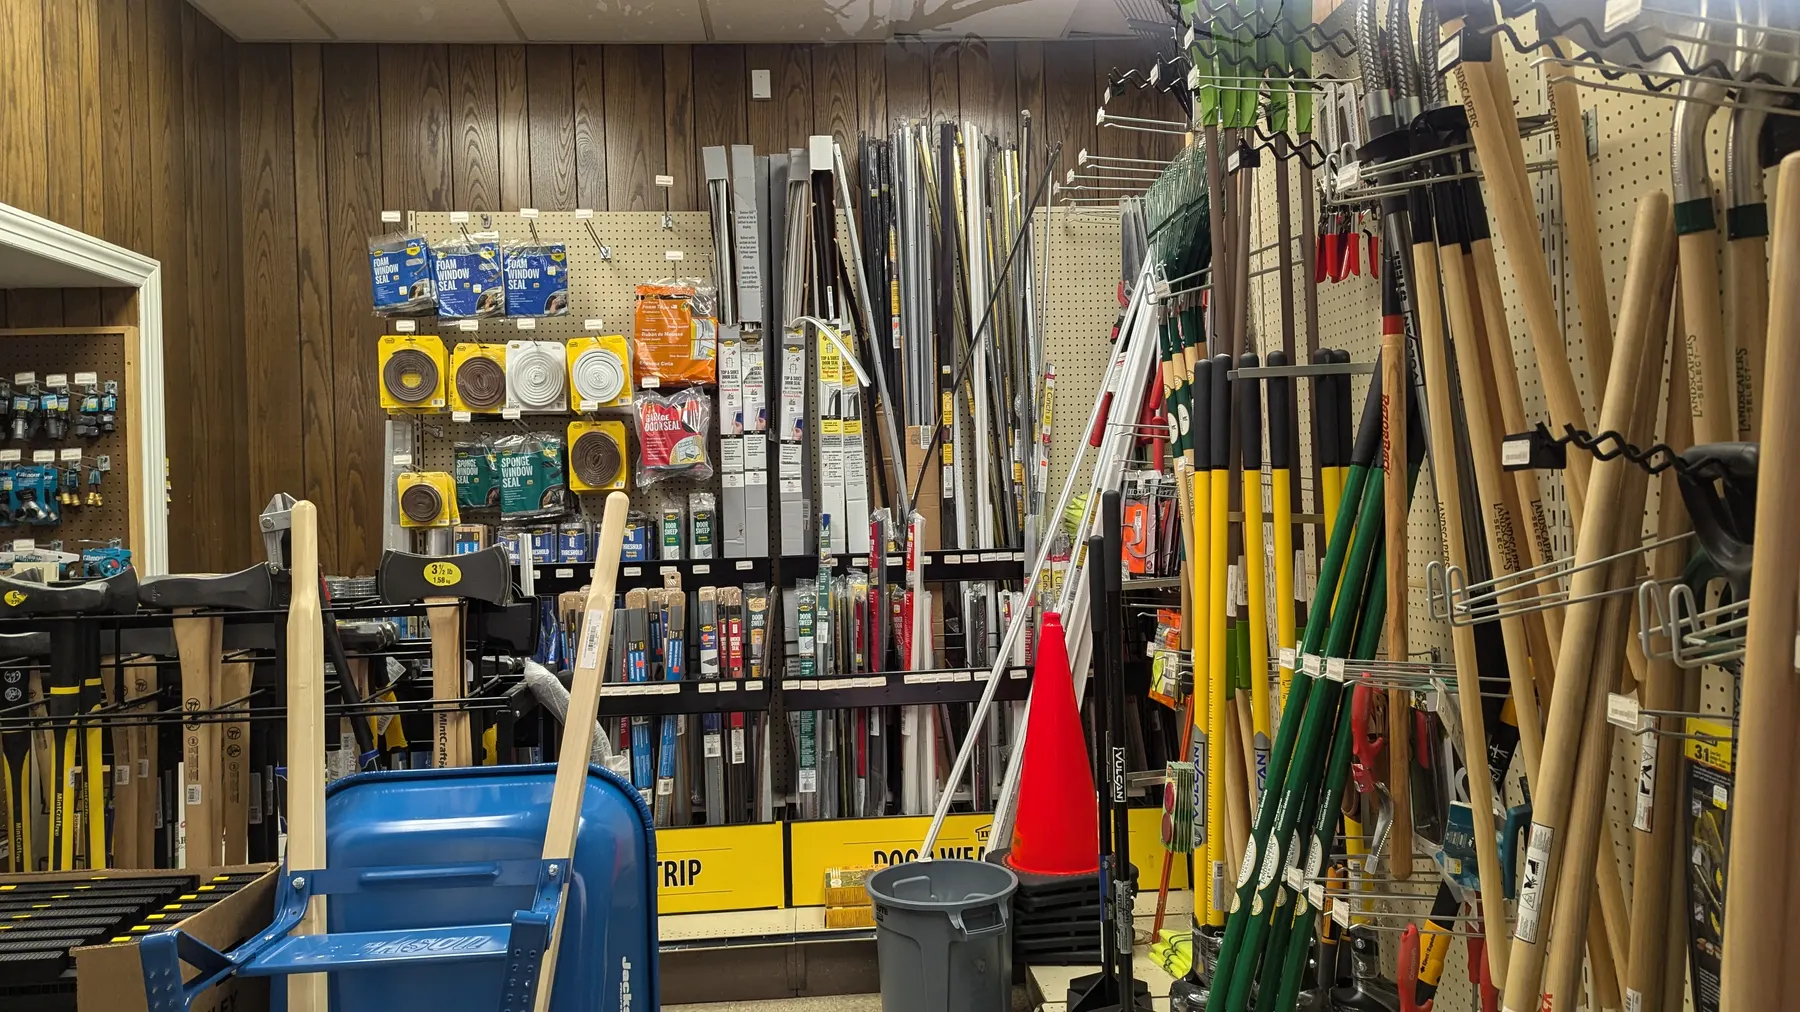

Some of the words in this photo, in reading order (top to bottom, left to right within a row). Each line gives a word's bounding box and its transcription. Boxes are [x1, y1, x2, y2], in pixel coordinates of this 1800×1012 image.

[1454, 66, 1480, 129] NDSCAPERS
[373, 256, 389, 267] FOAM
[436, 259, 457, 271] FOAM
[507, 258, 528, 269] FOAM
[374, 263, 399, 276] WINDOW
[436, 268, 470, 281] WINDOW
[507, 269, 540, 280] WINDOW
[375, 274, 390, 285] SEAL
[508, 280, 527, 290] SEAL
[438, 280, 458, 292] SEAL
[1686, 334, 1704, 418] LANDSCAPERS
[1736, 347, 1752, 432] LANDSCAPERS
[1045, 391, 1053, 414] Cinch
[645, 412, 670, 423] GARAGE
[644, 422, 663, 432] DOOR
[664, 420, 681, 431] SEAL
[456, 458, 477, 468] SPONGE
[501, 456, 530, 468] SPONGE
[456, 467, 479, 476] WINDOW
[501, 466, 533, 478] WINDOW
[456, 475, 470, 484] SEAL
[502, 478, 521, 488] SEAL
[1530, 499, 1555, 565] LANDSCAPER
[1531, 516, 1545, 553] SELECT
[1493, 519, 1505, 559] SELECT
[1115, 750, 1125, 800] VULCAN
[873, 847, 935, 867] DOO
[940, 845, 986, 861] WEA
[656, 858, 702, 888] TRIP
